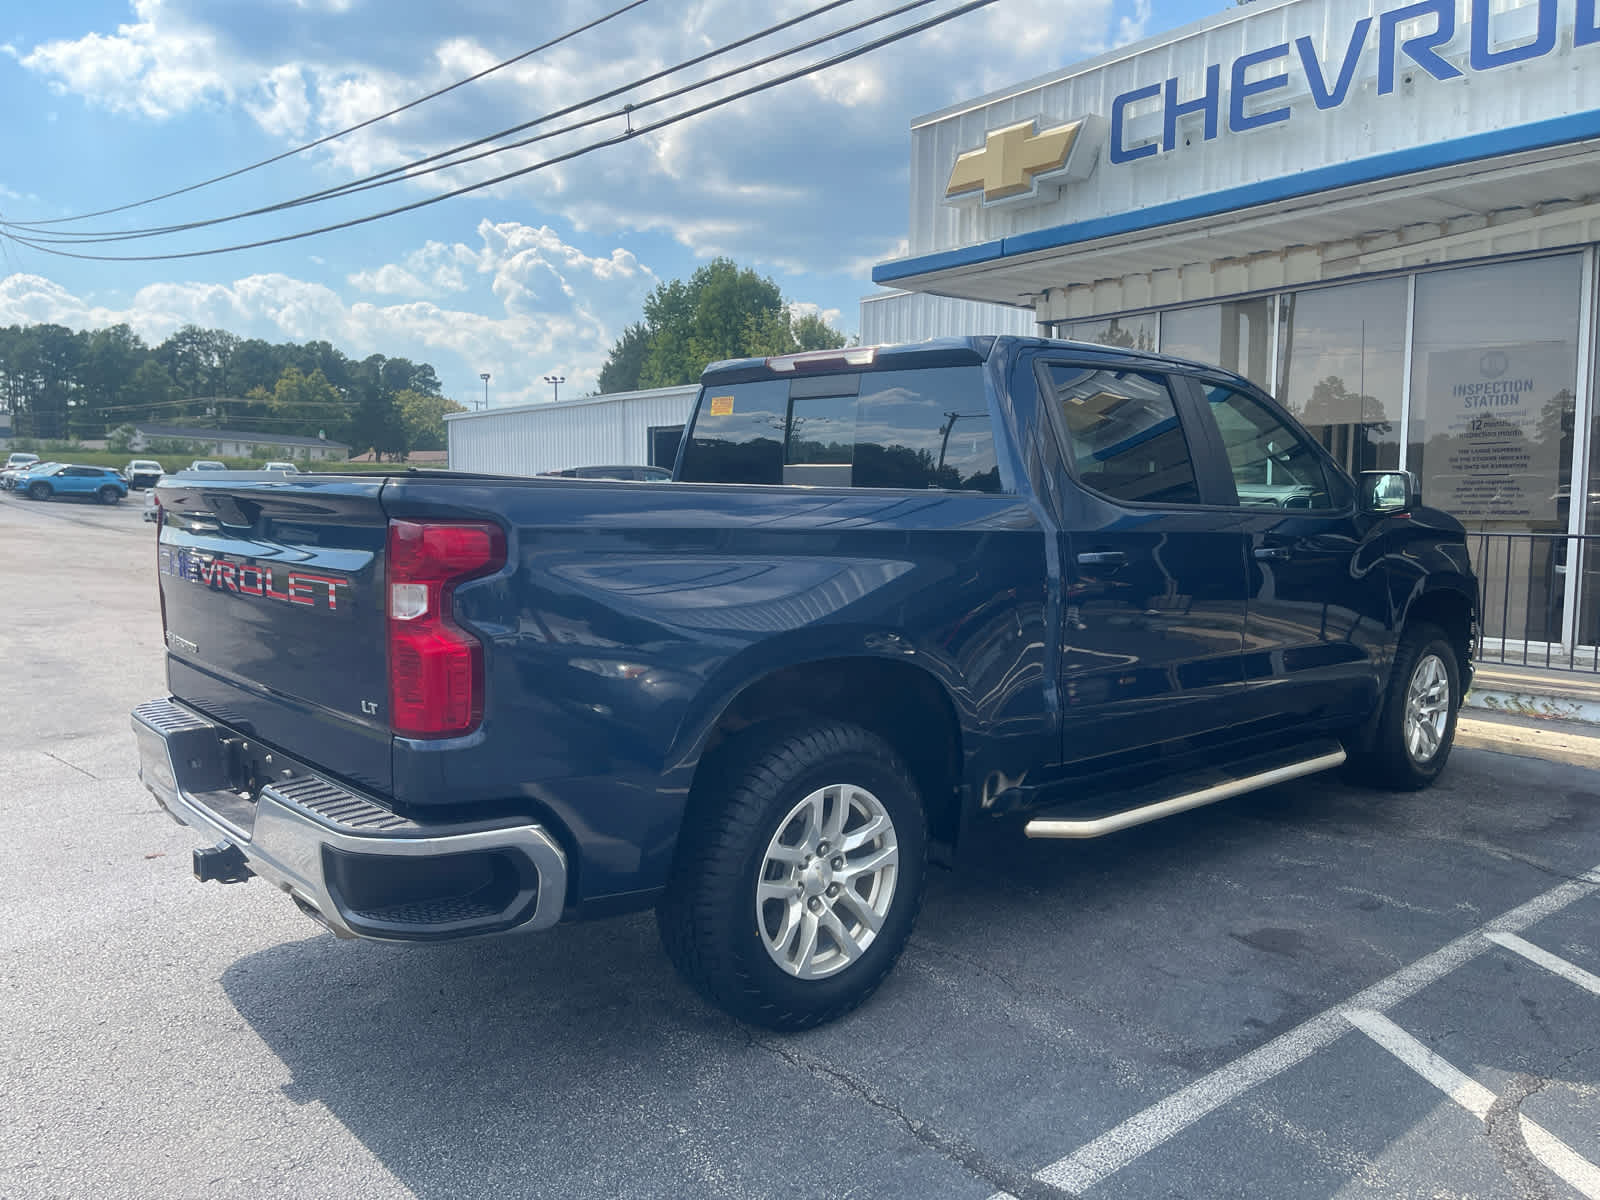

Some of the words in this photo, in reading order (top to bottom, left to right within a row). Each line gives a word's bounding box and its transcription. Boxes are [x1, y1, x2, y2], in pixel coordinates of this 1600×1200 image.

[1453, 378, 1534, 398] INSPECTION
[1464, 393, 1520, 409] STATION
[1471, 419, 1482, 431] 12
[361, 700, 378, 715] LT
